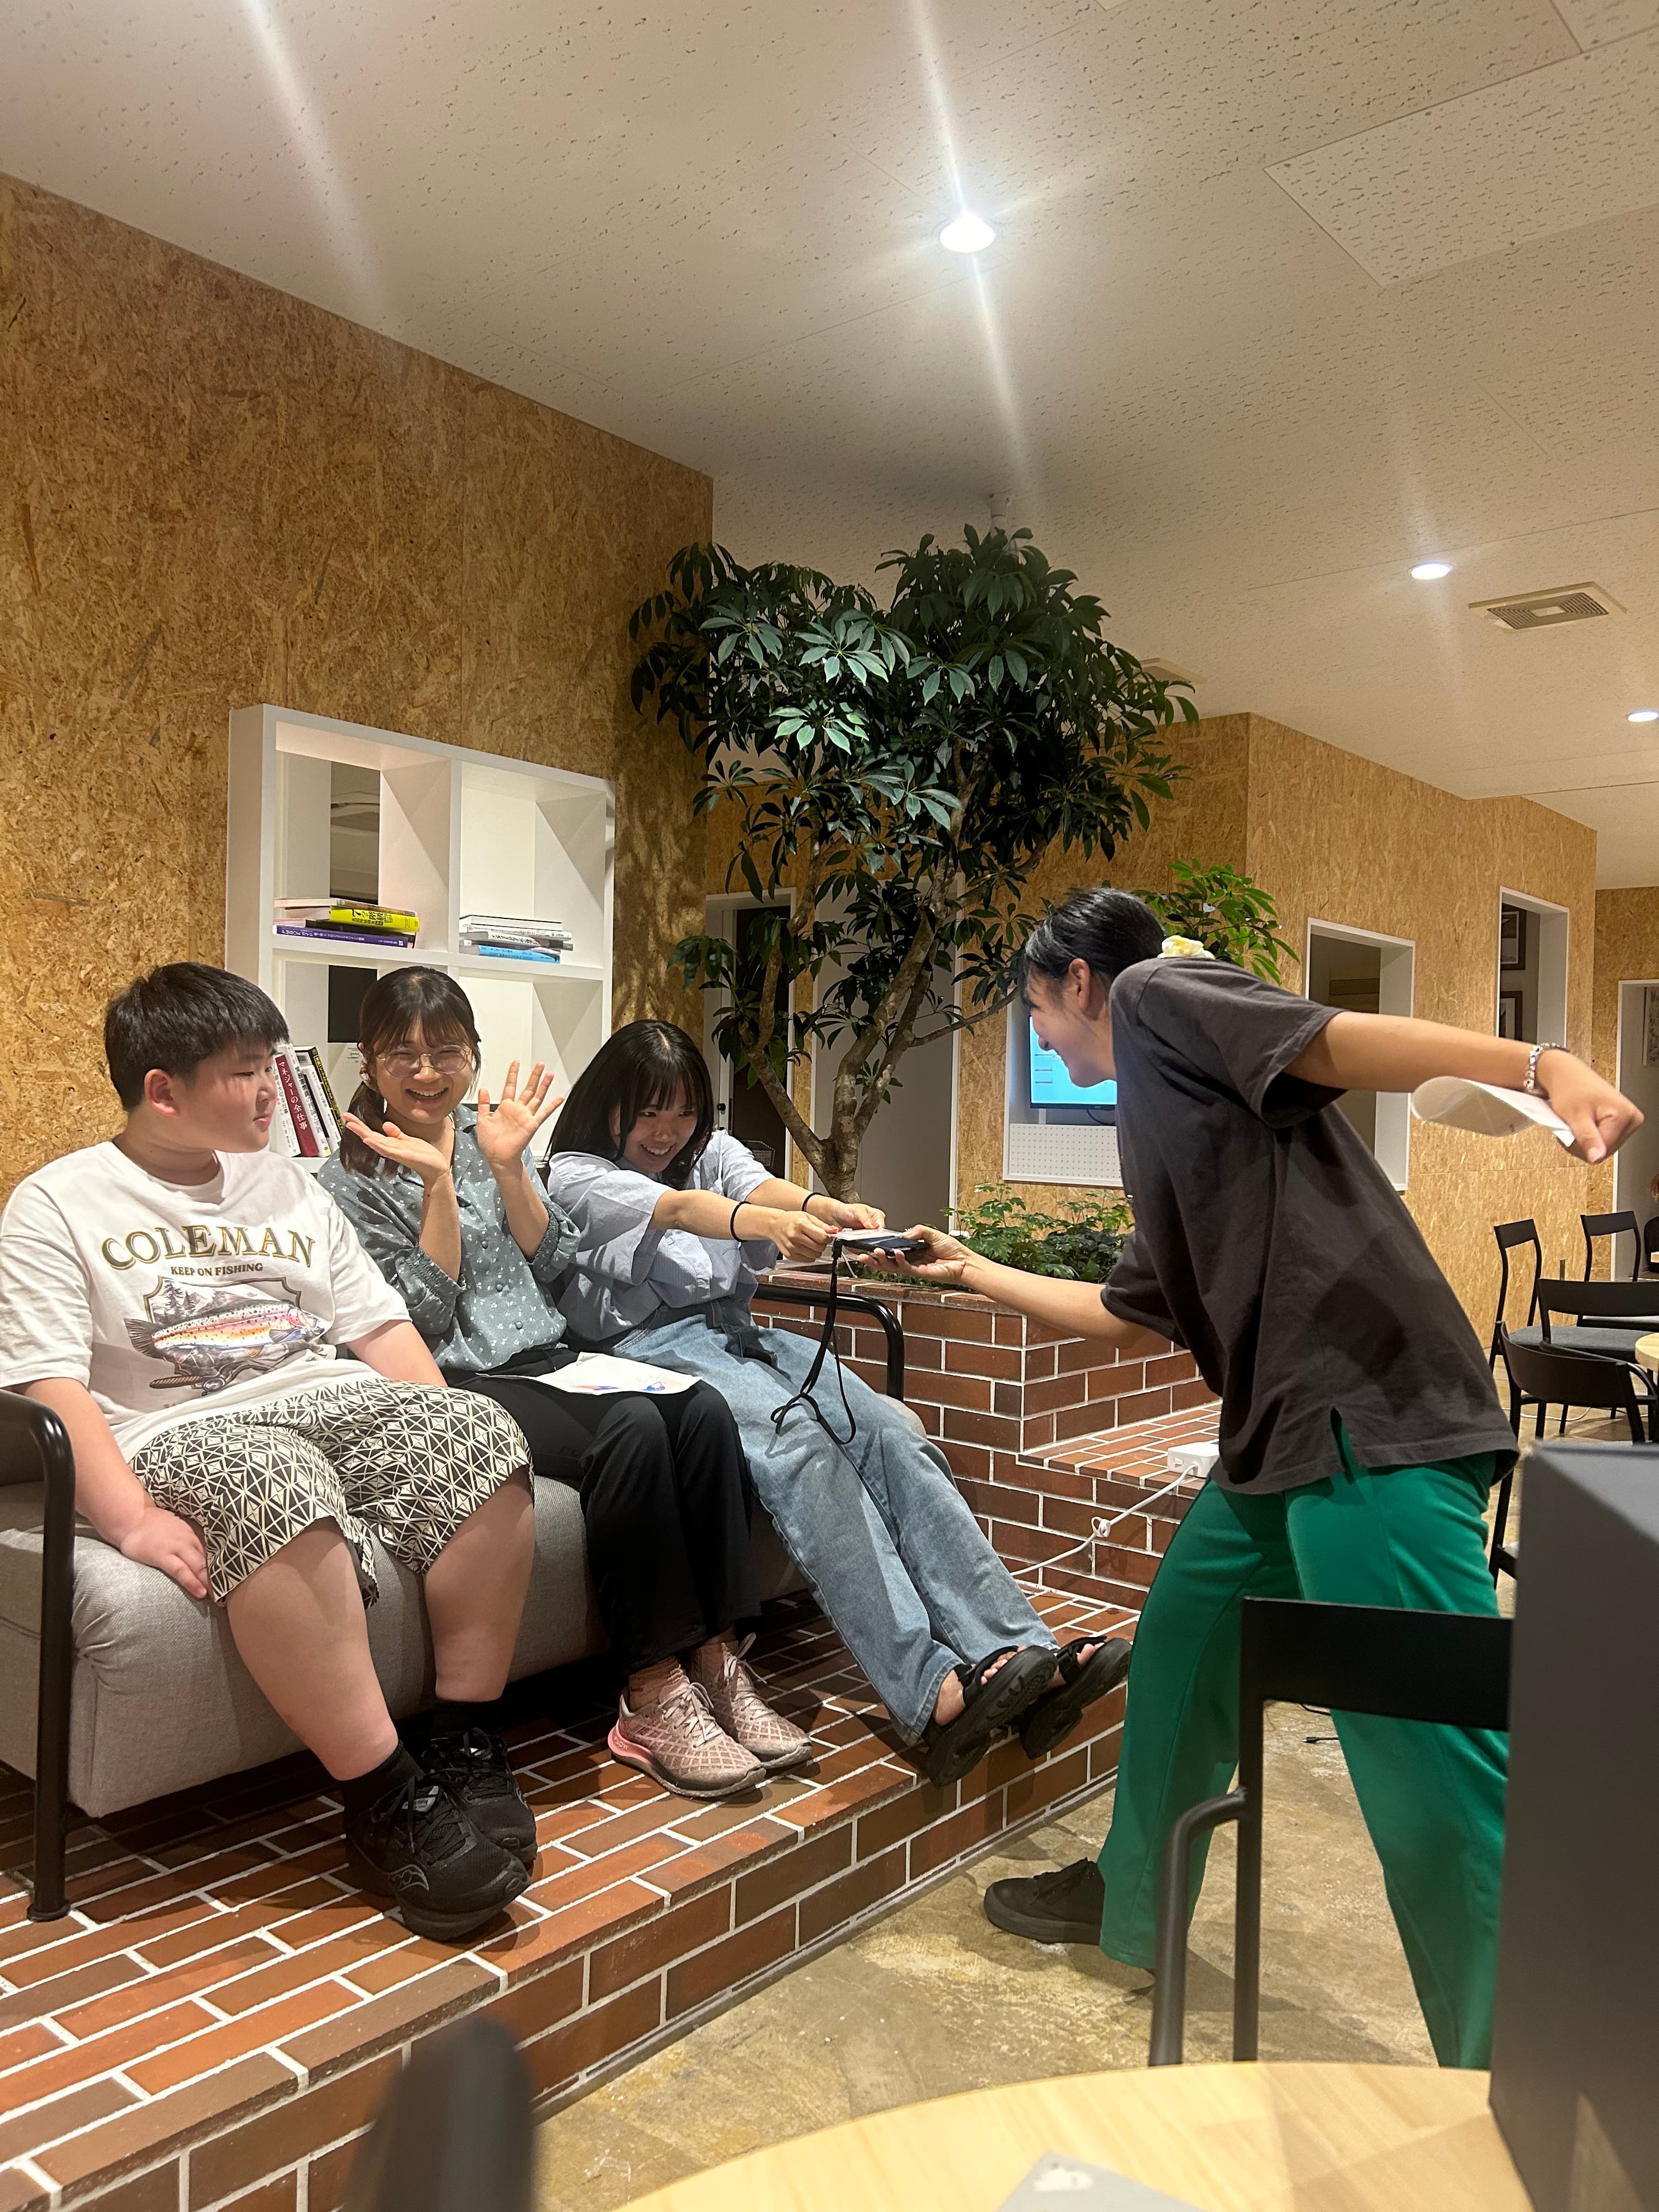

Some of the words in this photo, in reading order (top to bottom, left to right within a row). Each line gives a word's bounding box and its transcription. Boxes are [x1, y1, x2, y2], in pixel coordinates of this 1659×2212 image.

[278, 1062, 308, 1130] マネジャーの全仕事
[101, 1224, 315, 1270] COLEMAN
[171, 1266, 195, 1277] KEEP
[197, 1267, 212, 1277] ON
[215, 1263, 263, 1276] FISHING
